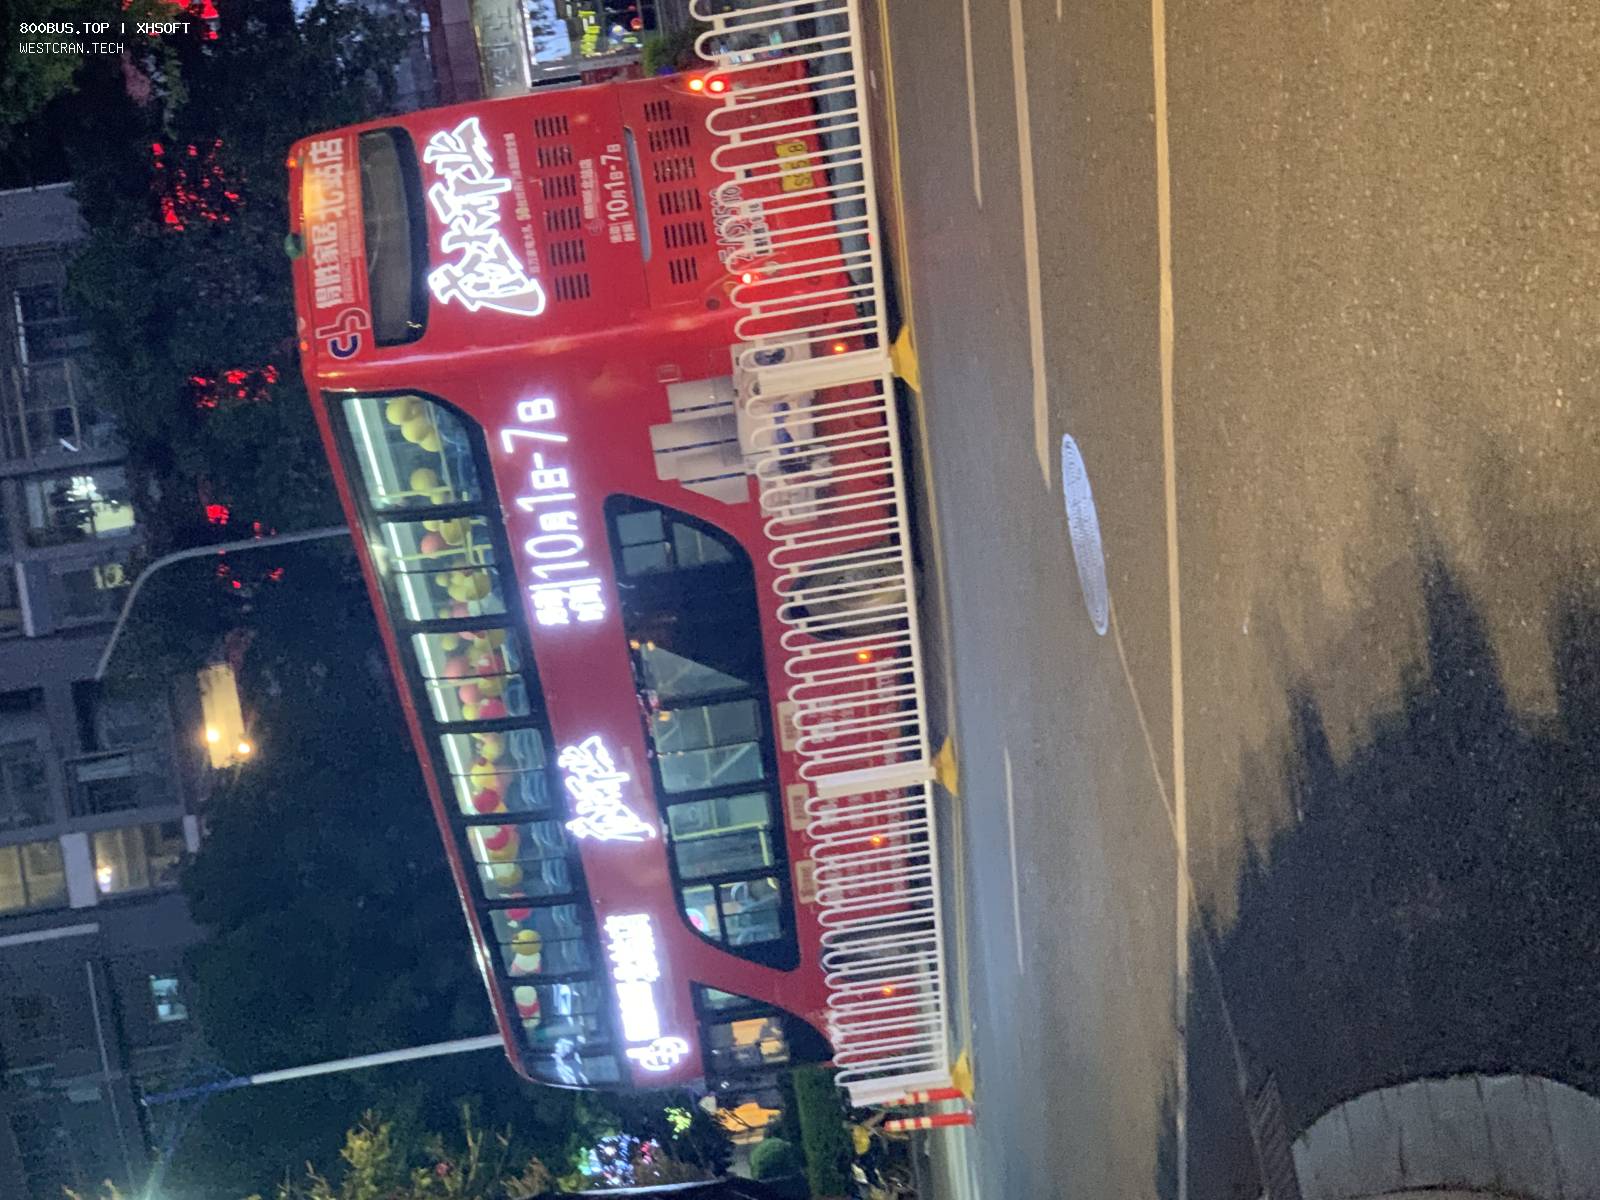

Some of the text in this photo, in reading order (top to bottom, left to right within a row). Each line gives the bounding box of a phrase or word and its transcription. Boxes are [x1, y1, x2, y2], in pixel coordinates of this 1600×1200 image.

[600, 143, 630, 221] 10月1日-7日
[501, 398, 589, 580] 10月1日-7日
